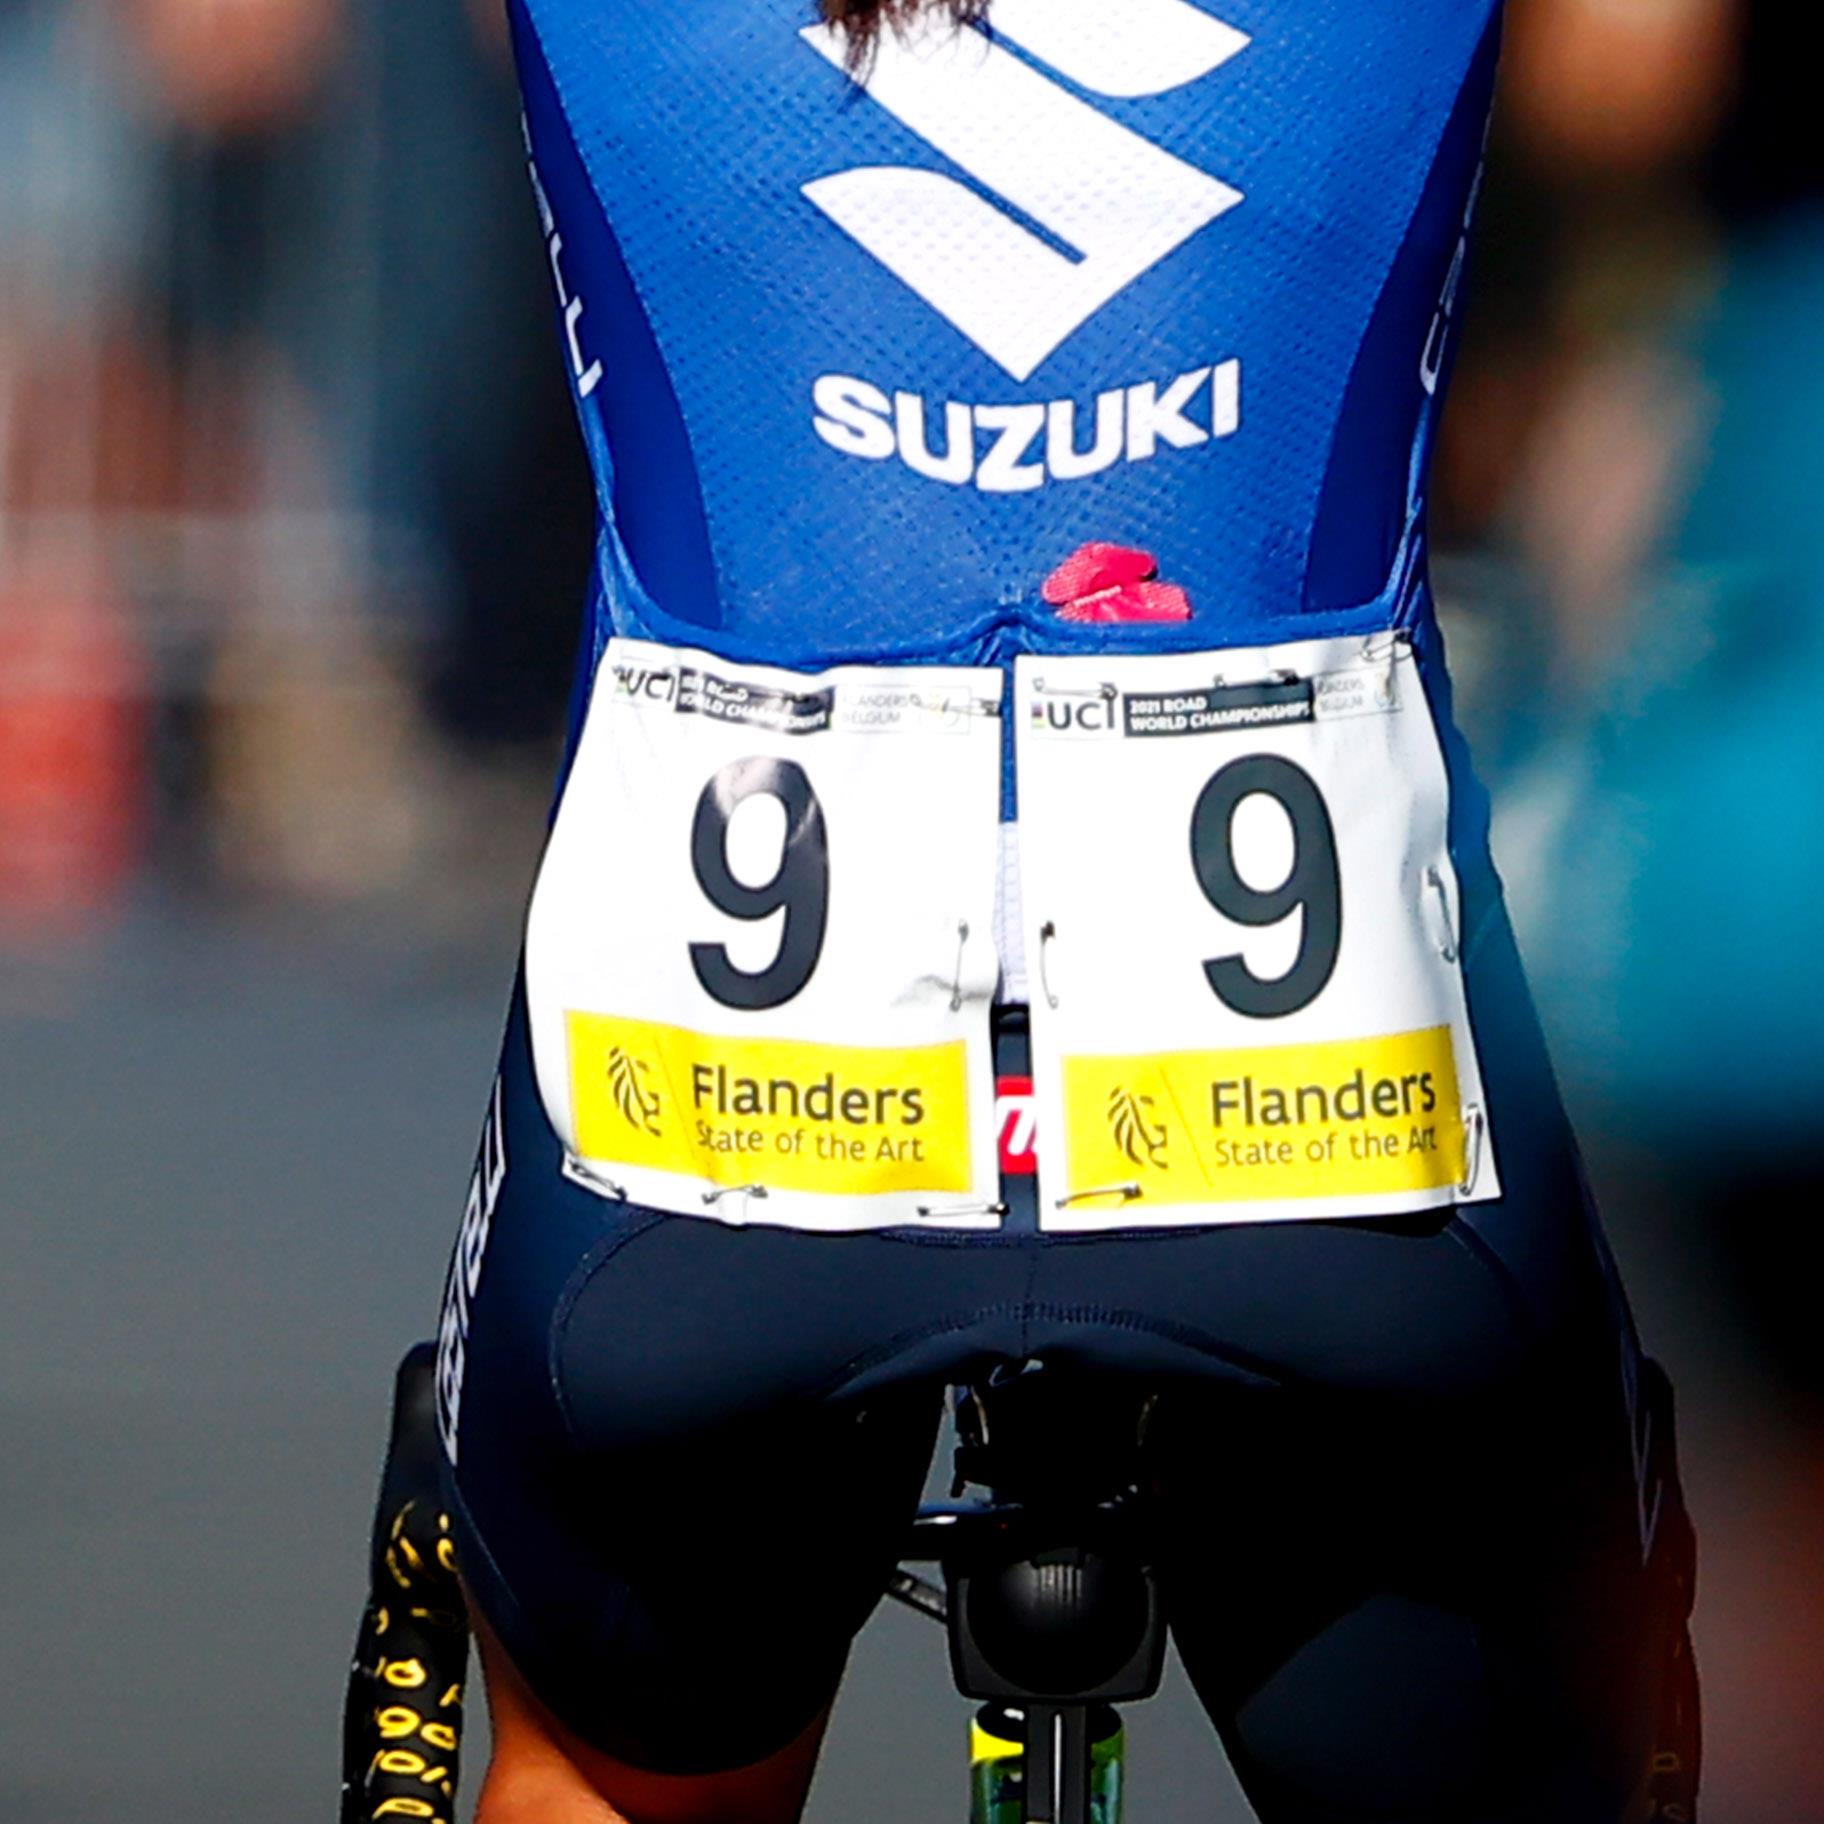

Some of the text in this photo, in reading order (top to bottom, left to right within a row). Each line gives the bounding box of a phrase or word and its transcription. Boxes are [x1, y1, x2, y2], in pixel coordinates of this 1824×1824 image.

[812, 357, 1241, 493] SUZUKI
[1046, 698, 1115, 731] UCI
[1129, 714, 1187, 731] WORLD
[1189, 701, 1311, 729] CHAMPIONSHIPS
[1163, 696, 1208, 714] ROAD
[687, 755, 830, 1011] 9
[1189, 752, 1343, 1019] 9
[692, 1062, 925, 1126] Flanders
[1212, 1067, 1436, 1128] Flanders
[695, 1119, 924, 1163] State of the Art
[1215, 1125, 1438, 1168] State of the Art
